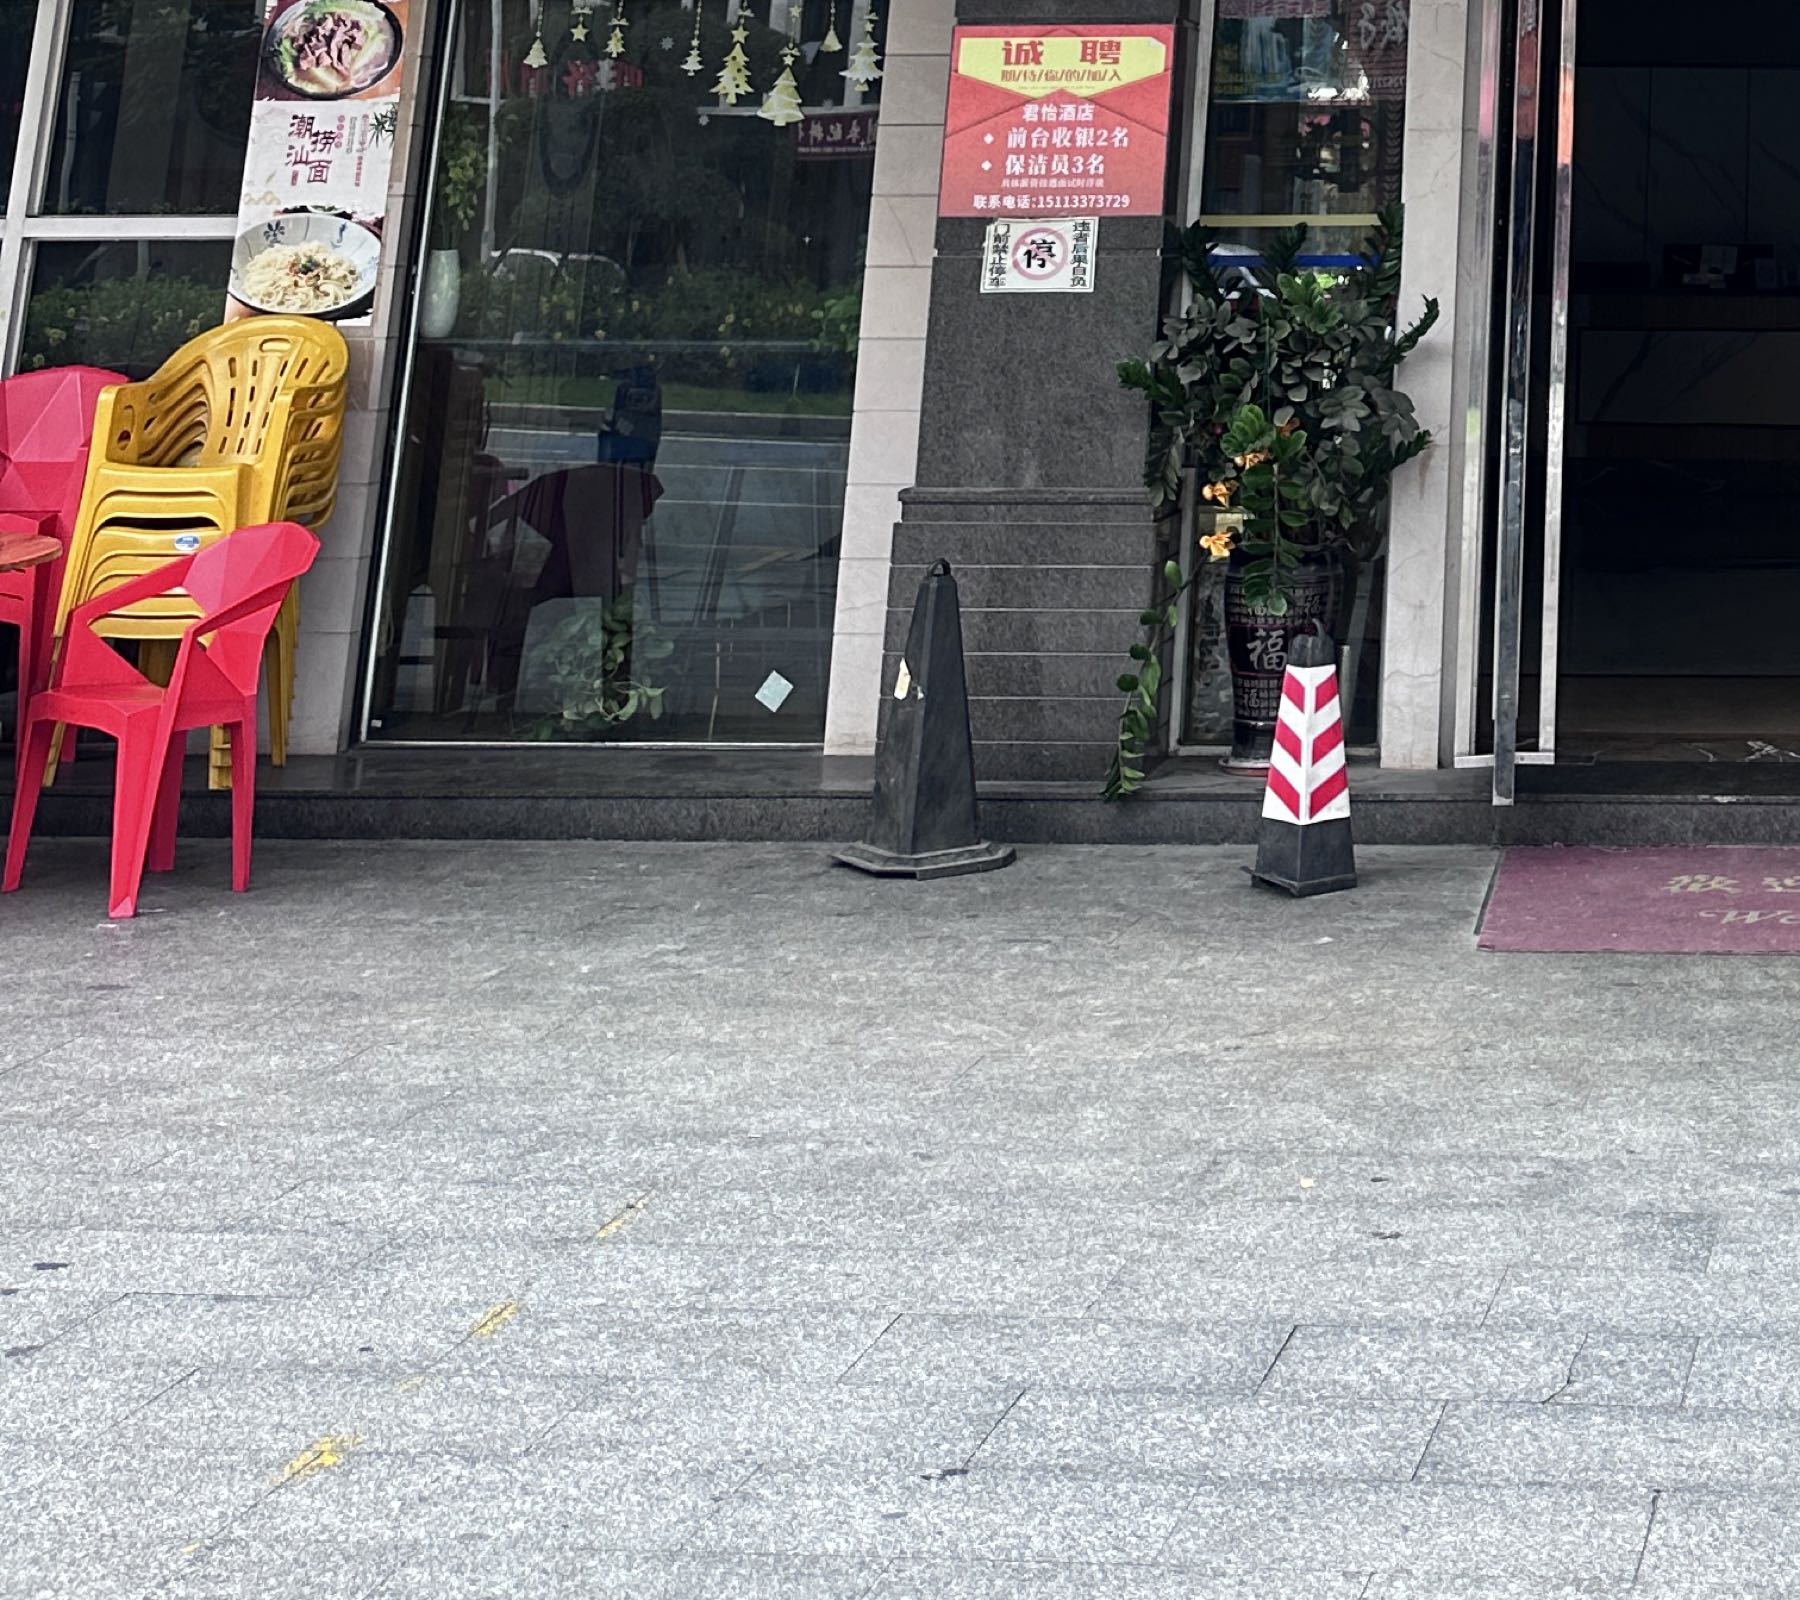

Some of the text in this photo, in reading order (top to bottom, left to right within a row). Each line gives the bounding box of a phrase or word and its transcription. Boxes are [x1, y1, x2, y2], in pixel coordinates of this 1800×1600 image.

[1022, 104, 1095, 122] 君怡酒店
[1006, 126, 1129, 149] 前台收银2名
[1005, 153, 1105, 176] 保洁员3名
[973, 194, 1131, 209] 联系电话:15113373729
[1023, 238, 1057, 269] 停
[1246, 628, 1289, 672] 福
